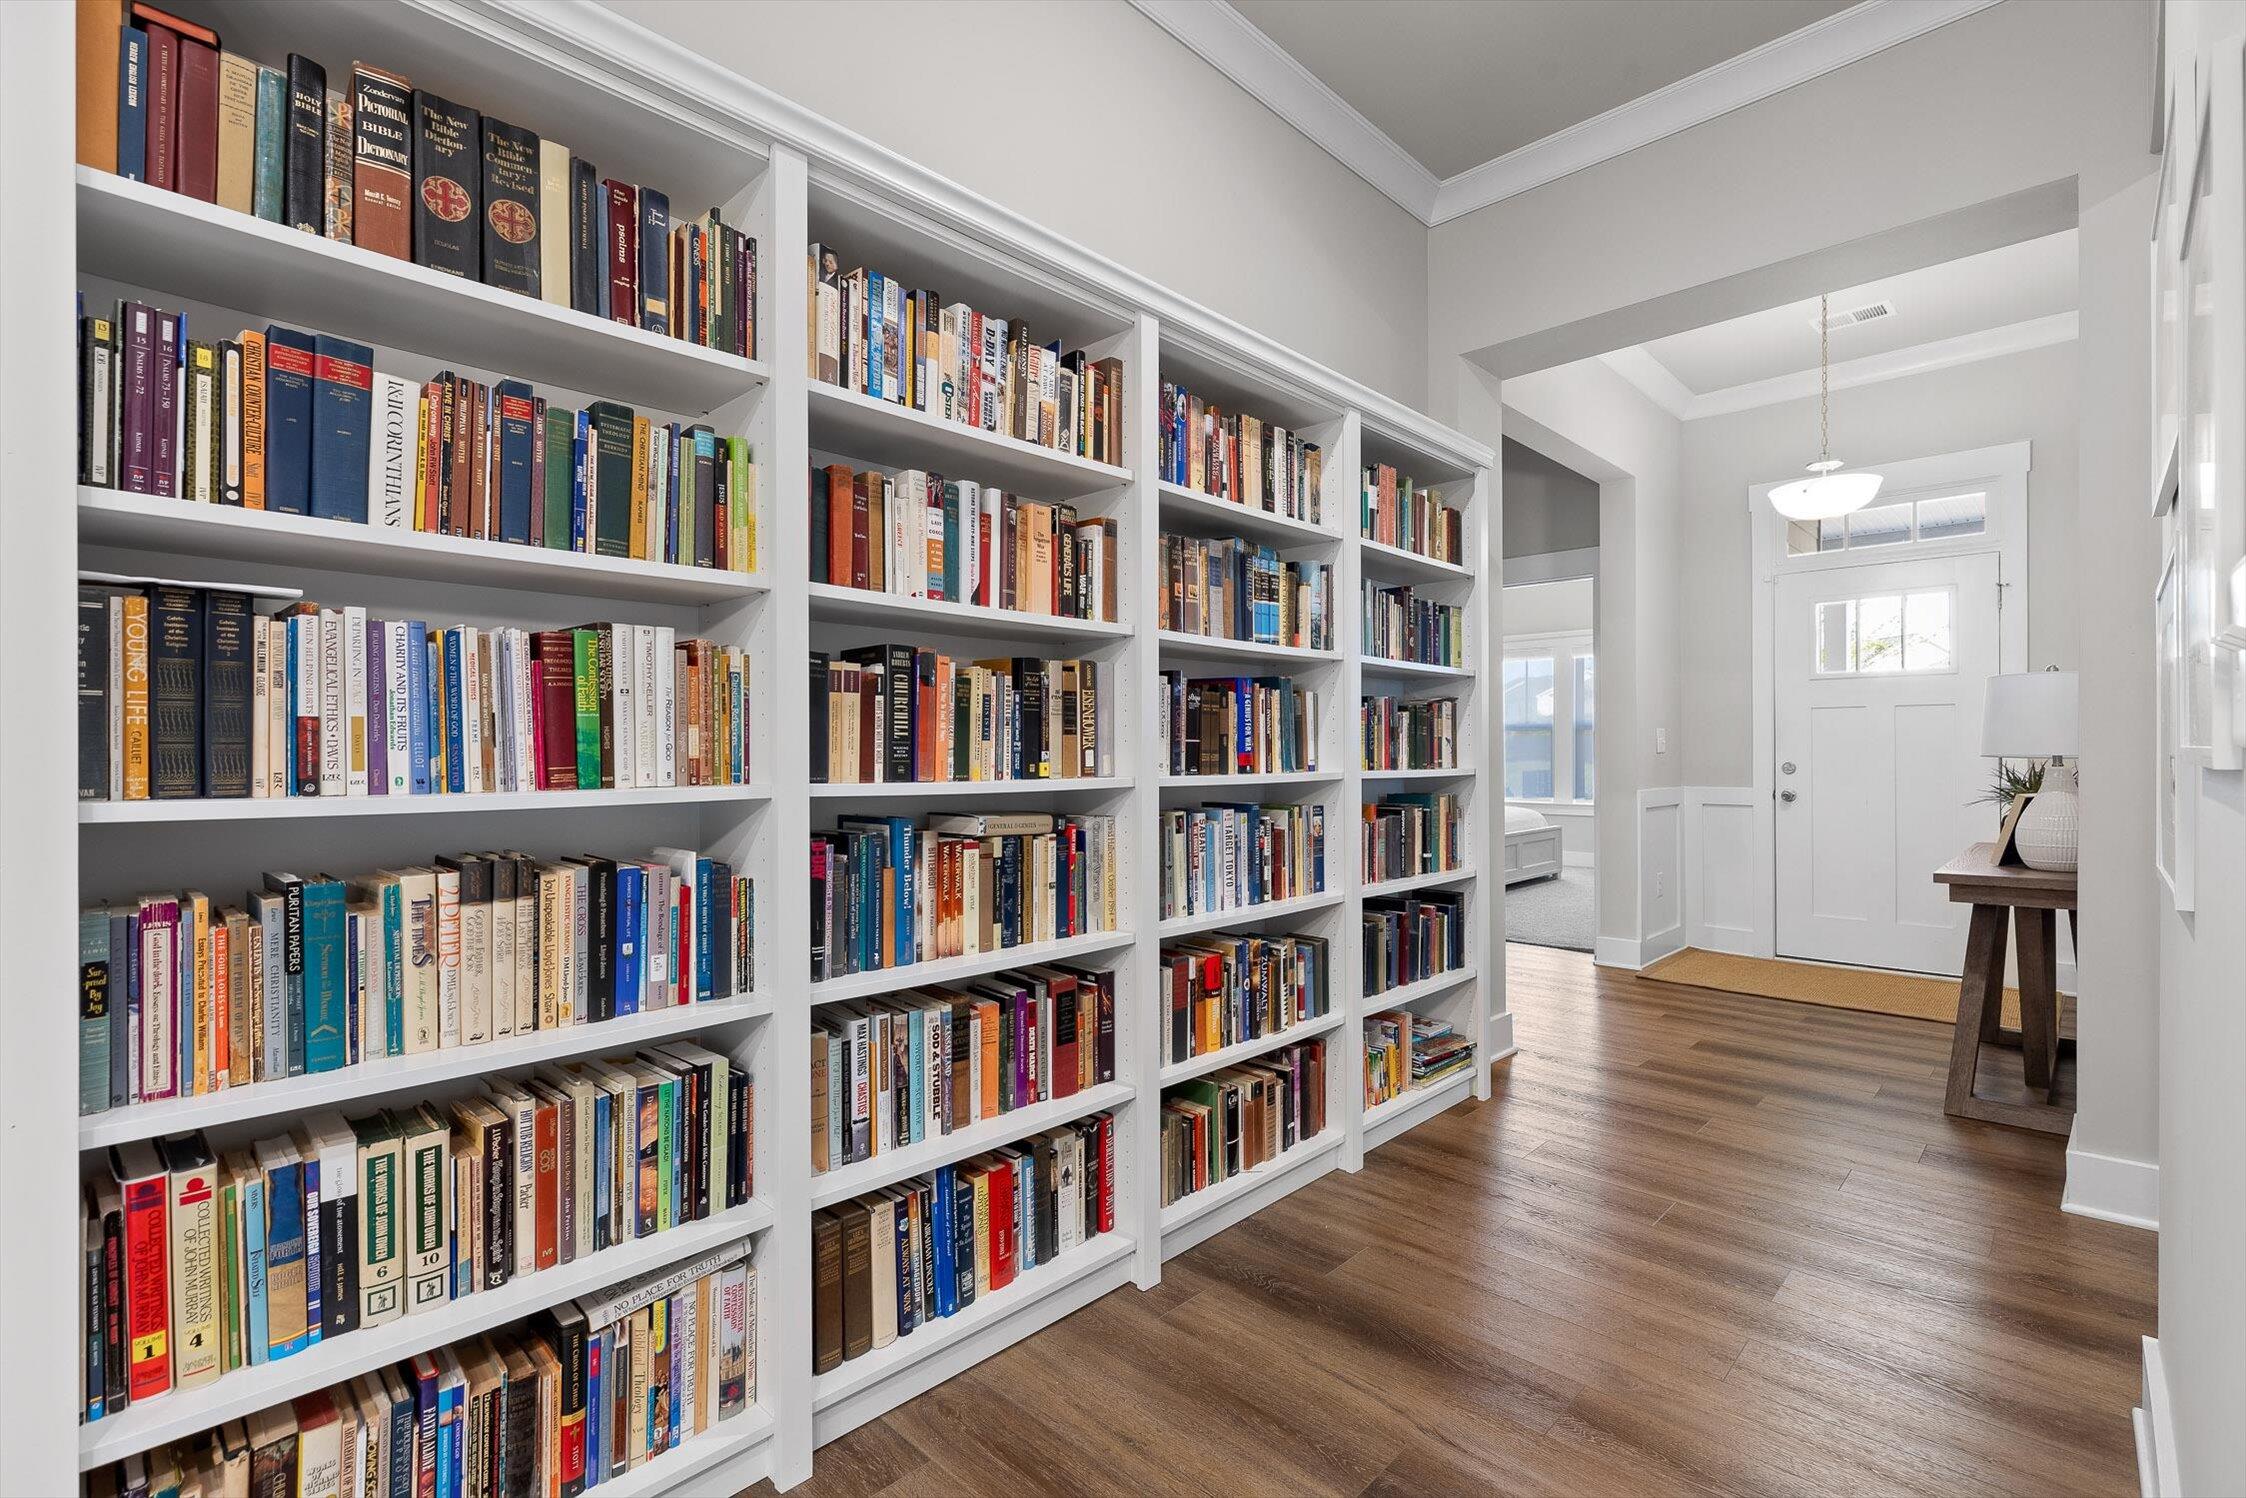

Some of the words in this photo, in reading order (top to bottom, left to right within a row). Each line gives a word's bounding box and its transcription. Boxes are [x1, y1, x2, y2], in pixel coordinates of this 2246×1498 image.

[129, 41, 138, 62] HEBREW
[129, 63, 138, 83] ENGLISH
[129, 85, 138, 108] LEXICON
[358, 94, 409, 126] PICTORIAL
[362, 121, 403, 141] BIBLE
[432, 122, 459, 138] Bible
[358, 136, 409, 167] DICTIONARY
[492, 174, 535, 195] Revised
[616, 224, 627, 264] psalms
[246, 340, 261, 382] CHRISTIAN
[985, 328, 996, 368] D-DAY
[444, 382, 452, 403] ALIVE
[246, 384, 262, 455] COUNTER-CULTURE
[443, 415, 451, 443] CHRIST
[385, 411, 404, 528] CORINTHIANS
[1063, 578, 1072, 596] LIFE
[305, 618, 314, 644] WHEN
[127, 613, 147, 682] YOUNG
[325, 620, 337, 692] EVANGELICAL
[395, 626, 406, 671] CHARITY
[589, 640, 598, 656] The
[645, 641, 653, 680] TIMOTHY
[305, 647, 314, 685] HELPING
[577, 675, 587, 685] of
[396, 673, 406, 694] AND
[589, 658, 599, 711] Confession
[127, 690, 147, 725] LIFE
[305, 688, 315, 714] HURTS
[326, 695, 338, 732] ETHICS
[388, 689, 396, 720] Jonathan
[397, 697, 406, 712] ITS
[578, 687, 588, 711] Faith
[894, 674, 909, 739] CHURCHILL
[397, 716, 407, 752] FRUITS
[1082, 689, 1094, 749] EISENHOWER
[326, 740, 338, 770] DAVIS
[903, 825, 912, 870] Thunder
[928, 847, 936, 890] BITTERROOT
[440, 886, 459, 897] 2
[544, 880, 556, 893] Joy
[577, 885, 586, 904] THE
[903, 874, 912, 909] Below!
[288, 887, 299, 933] PURITAN
[411, 893, 433, 925] THE
[544, 893, 556, 942] Unspeakable
[577, 906, 586, 936] CROSS
[270, 932, 280, 959] MERE
[411, 927, 433, 968] TIMES
[440, 901, 460, 968] PETER
[289, 936, 300, 971] PAPERS
[544, 945, 555, 989] Lloyd-Jones
[270, 966, 280, 1037] CHRISTIANITY
[545, 993, 555, 1013] Shaw
[857, 1023, 866, 1040] MAX
[932, 1024, 940, 1049] SOD
[857, 1040, 867, 1076] HASTINGS
[932, 1051, 940, 1060] &
[857, 1081, 867, 1116] CHASTISE
[932, 1063, 940, 1120] STUBBLE
[520, 1109, 532, 1123] HOT
[520, 1124, 532, 1140] TUB
[376, 1158, 388, 1173] THE
[424, 1149, 435, 1164] THE
[520, 1139, 532, 1173] RELIGION
[376, 1174, 388, 1202] WORKS
[424, 1164, 435, 1194] WORKS
[308, 1191, 318, 1208] OUR
[376, 1203, 388, 1213] OF
[424, 1195, 435, 1205] OF
[520, 1184, 532, 1209] Packer
[376, 1215, 388, 1236] JOHN
[424, 1206, 435, 1227] JOHN
[148, 1209, 161, 1274] COLLECTED
[184, 1229, 196, 1243] OF
[198, 1202, 212, 1267] COLLECTED
[308, 1211, 318, 1254] SOVEREIGN
[424, 1228, 435, 1249] OWEN
[912, 1218, 920, 1250] WINNING
[924, 1222, 932, 1259] ABRAHAM
[184, 1247, 196, 1278] JOHN
[376, 1237, 388, 1261] OWEN
[422, 1253, 440, 1267] 10
[902, 1238, 910, 1274] ALWAYS
[377, 1265, 388, 1278] 6
[613, 1300, 629, 1312] NO
[632, 1282, 664, 1302] PLACE
[666, 1271, 687, 1287] FOR
[687, 1254, 721, 1275] TRUTH
[903, 1277, 910, 1288] AT
[925, 1260, 933, 1295] LINCOLN
[149, 1277, 162, 1330] WRITINGS
[184, 1279, 197, 1325] MURRAY
[200, 1268, 213, 1322] WRITINGS
[724, 1287, 731, 1295] OF
[903, 1292, 911, 1315] WAR
[687, 1301, 695, 1314] NO
[190, 1334, 202, 1349] 4
[687, 1318, 695, 1346] PLACE
[144, 1345, 155, 1359] 1
[634, 1329, 645, 1366] Biblical
[687, 1350, 695, 1369] FOR
[572, 1372, 579, 1381] OF
[687, 1373, 695, 1405] TRUTH
[633, 1372, 645, 1414] Theology
[423, 1407, 436, 1438] FAITH
[422, 1442, 435, 1471] ALONE
